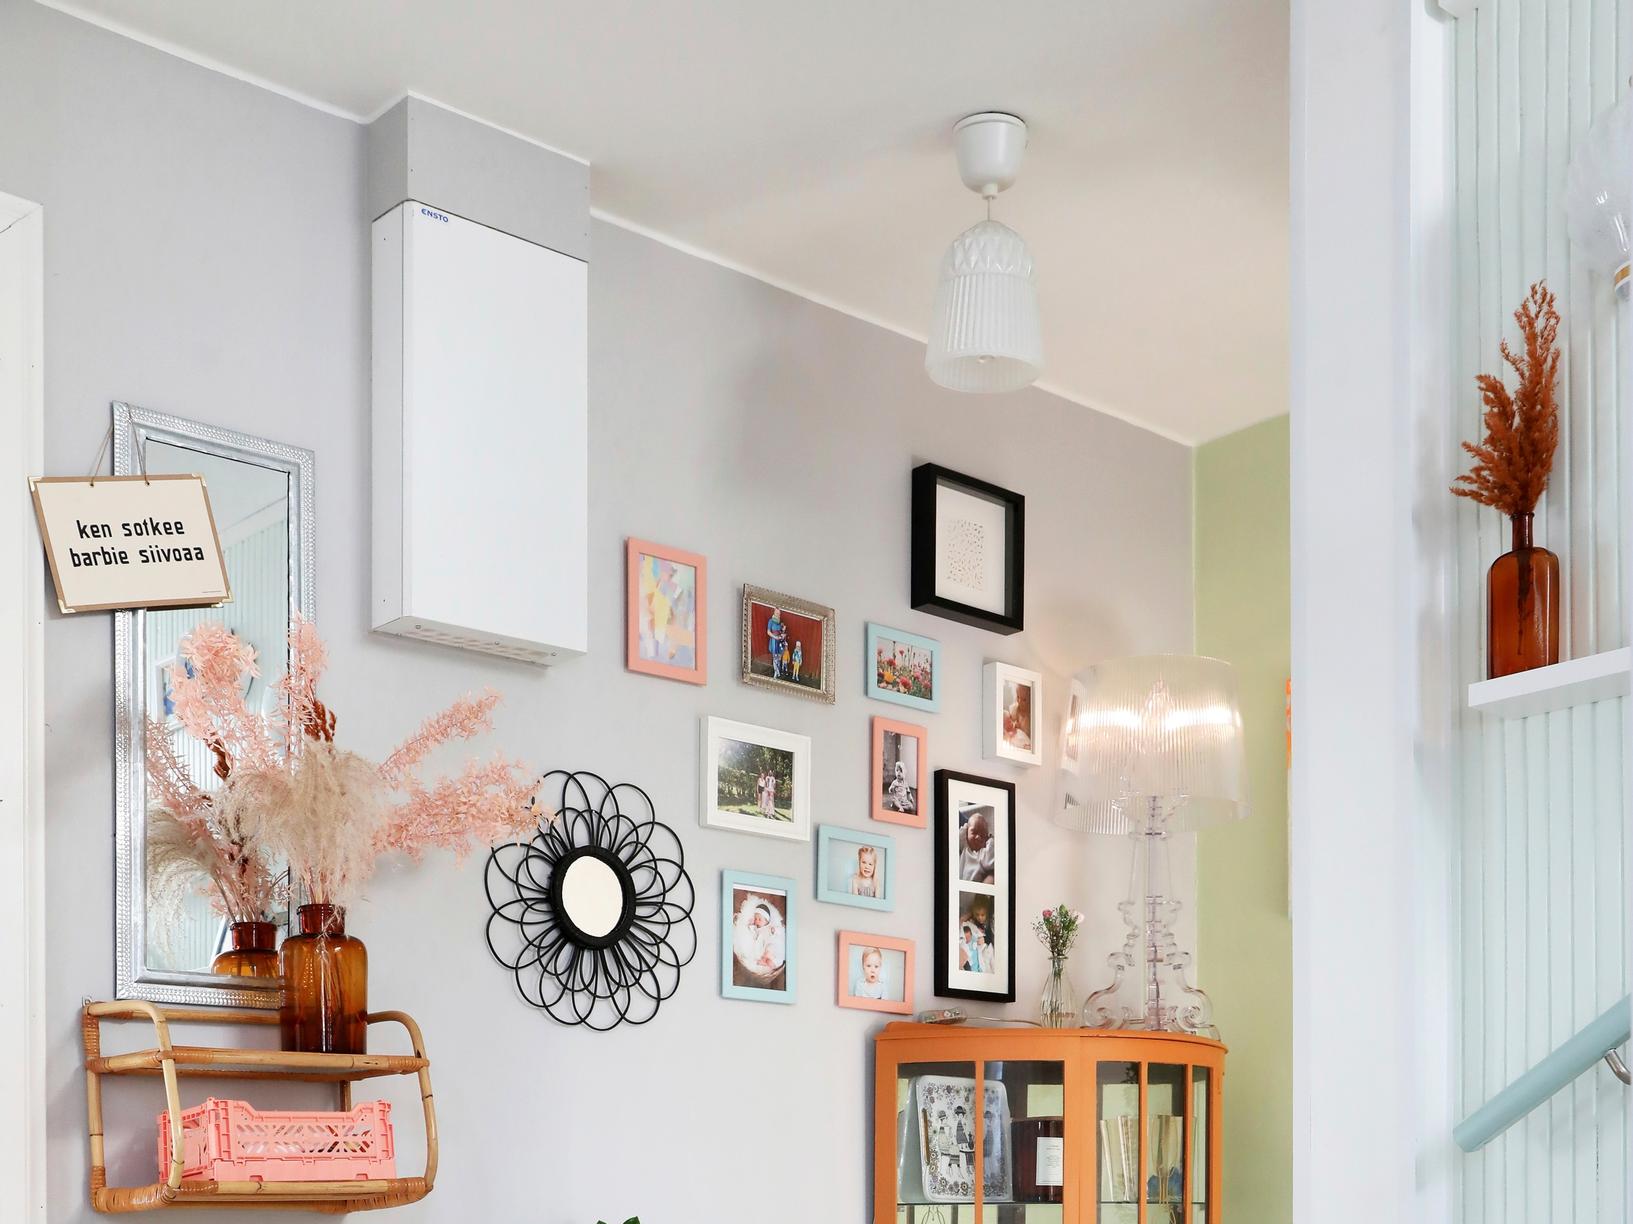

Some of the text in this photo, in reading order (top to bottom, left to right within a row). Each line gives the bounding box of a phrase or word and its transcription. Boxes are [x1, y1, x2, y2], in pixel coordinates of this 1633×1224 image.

[76, 517, 185, 539] ken sotkee
[69, 544, 205, 567] barbie siivoaa
